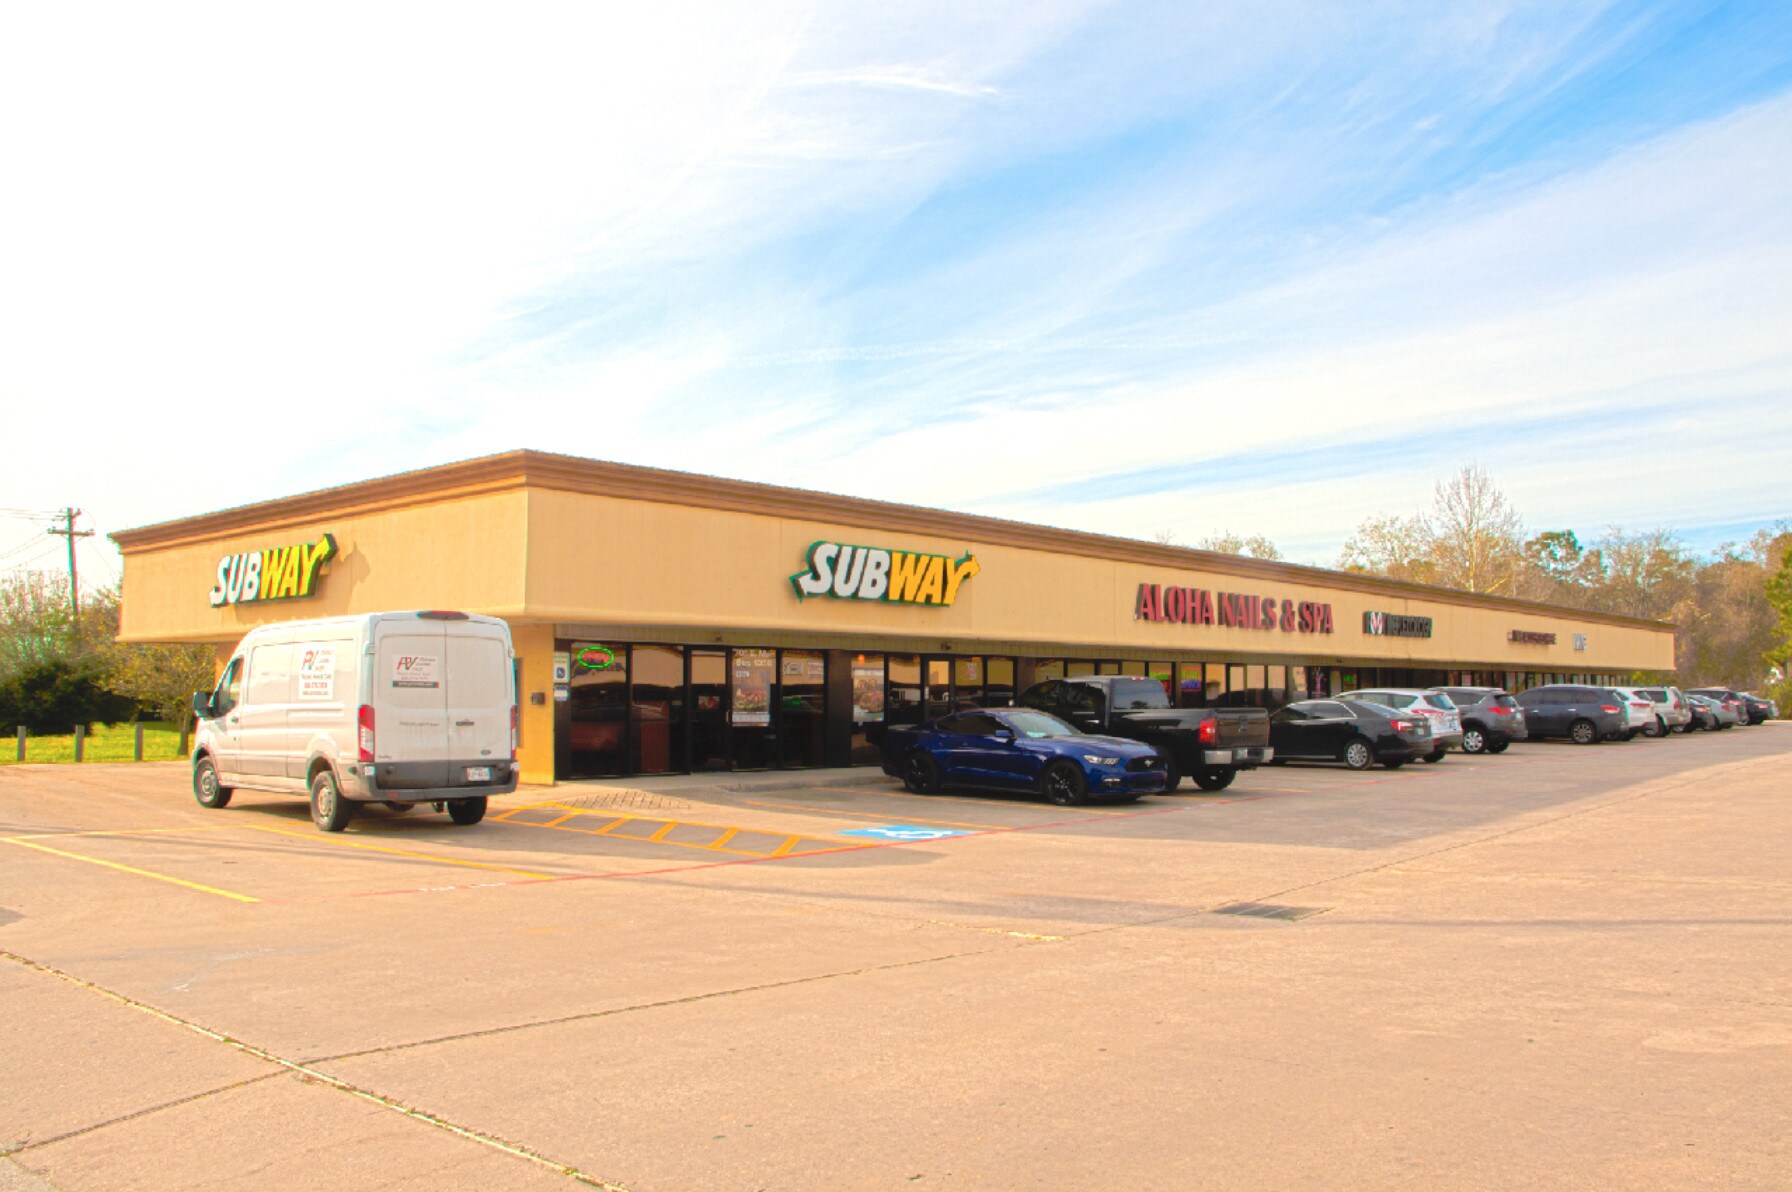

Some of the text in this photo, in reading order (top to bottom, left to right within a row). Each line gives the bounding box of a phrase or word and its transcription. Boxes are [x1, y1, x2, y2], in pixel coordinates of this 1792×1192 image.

[209, 533, 337, 606] SUBWAY
[797, 542, 981, 606] SUBWAY
[1135, 582, 1334, 633] ALOHA NAILS & SPA
